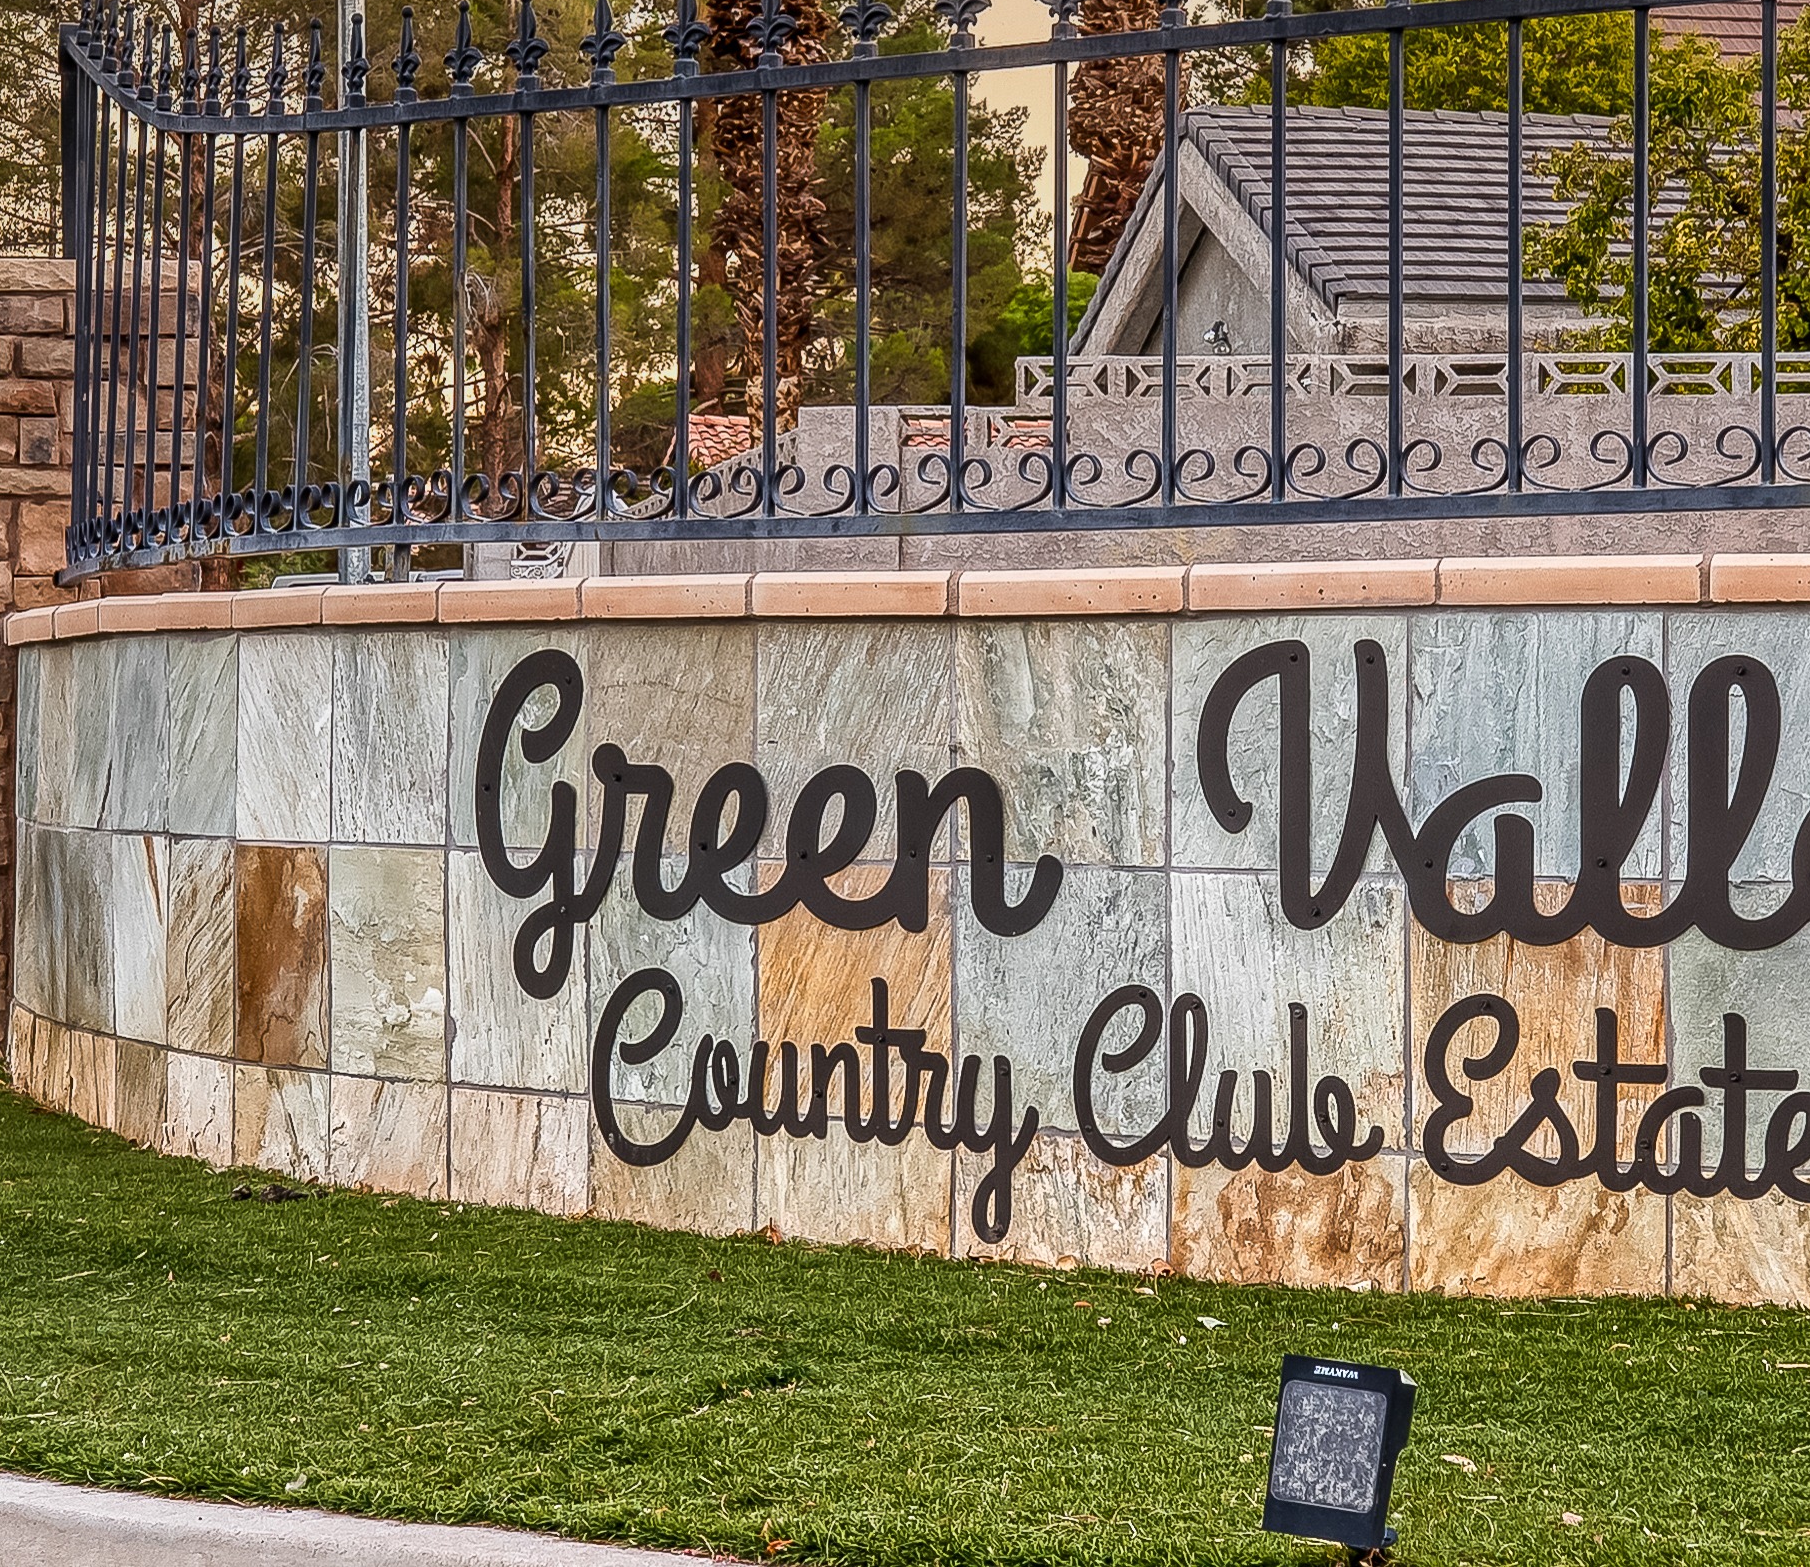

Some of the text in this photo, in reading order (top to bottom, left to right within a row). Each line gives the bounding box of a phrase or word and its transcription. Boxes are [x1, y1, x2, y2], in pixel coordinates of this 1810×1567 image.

[475, 647, 1064, 1000] Green
[590, 967, 1040, 1244] Country
[1072, 983, 1385, 1175] Club
